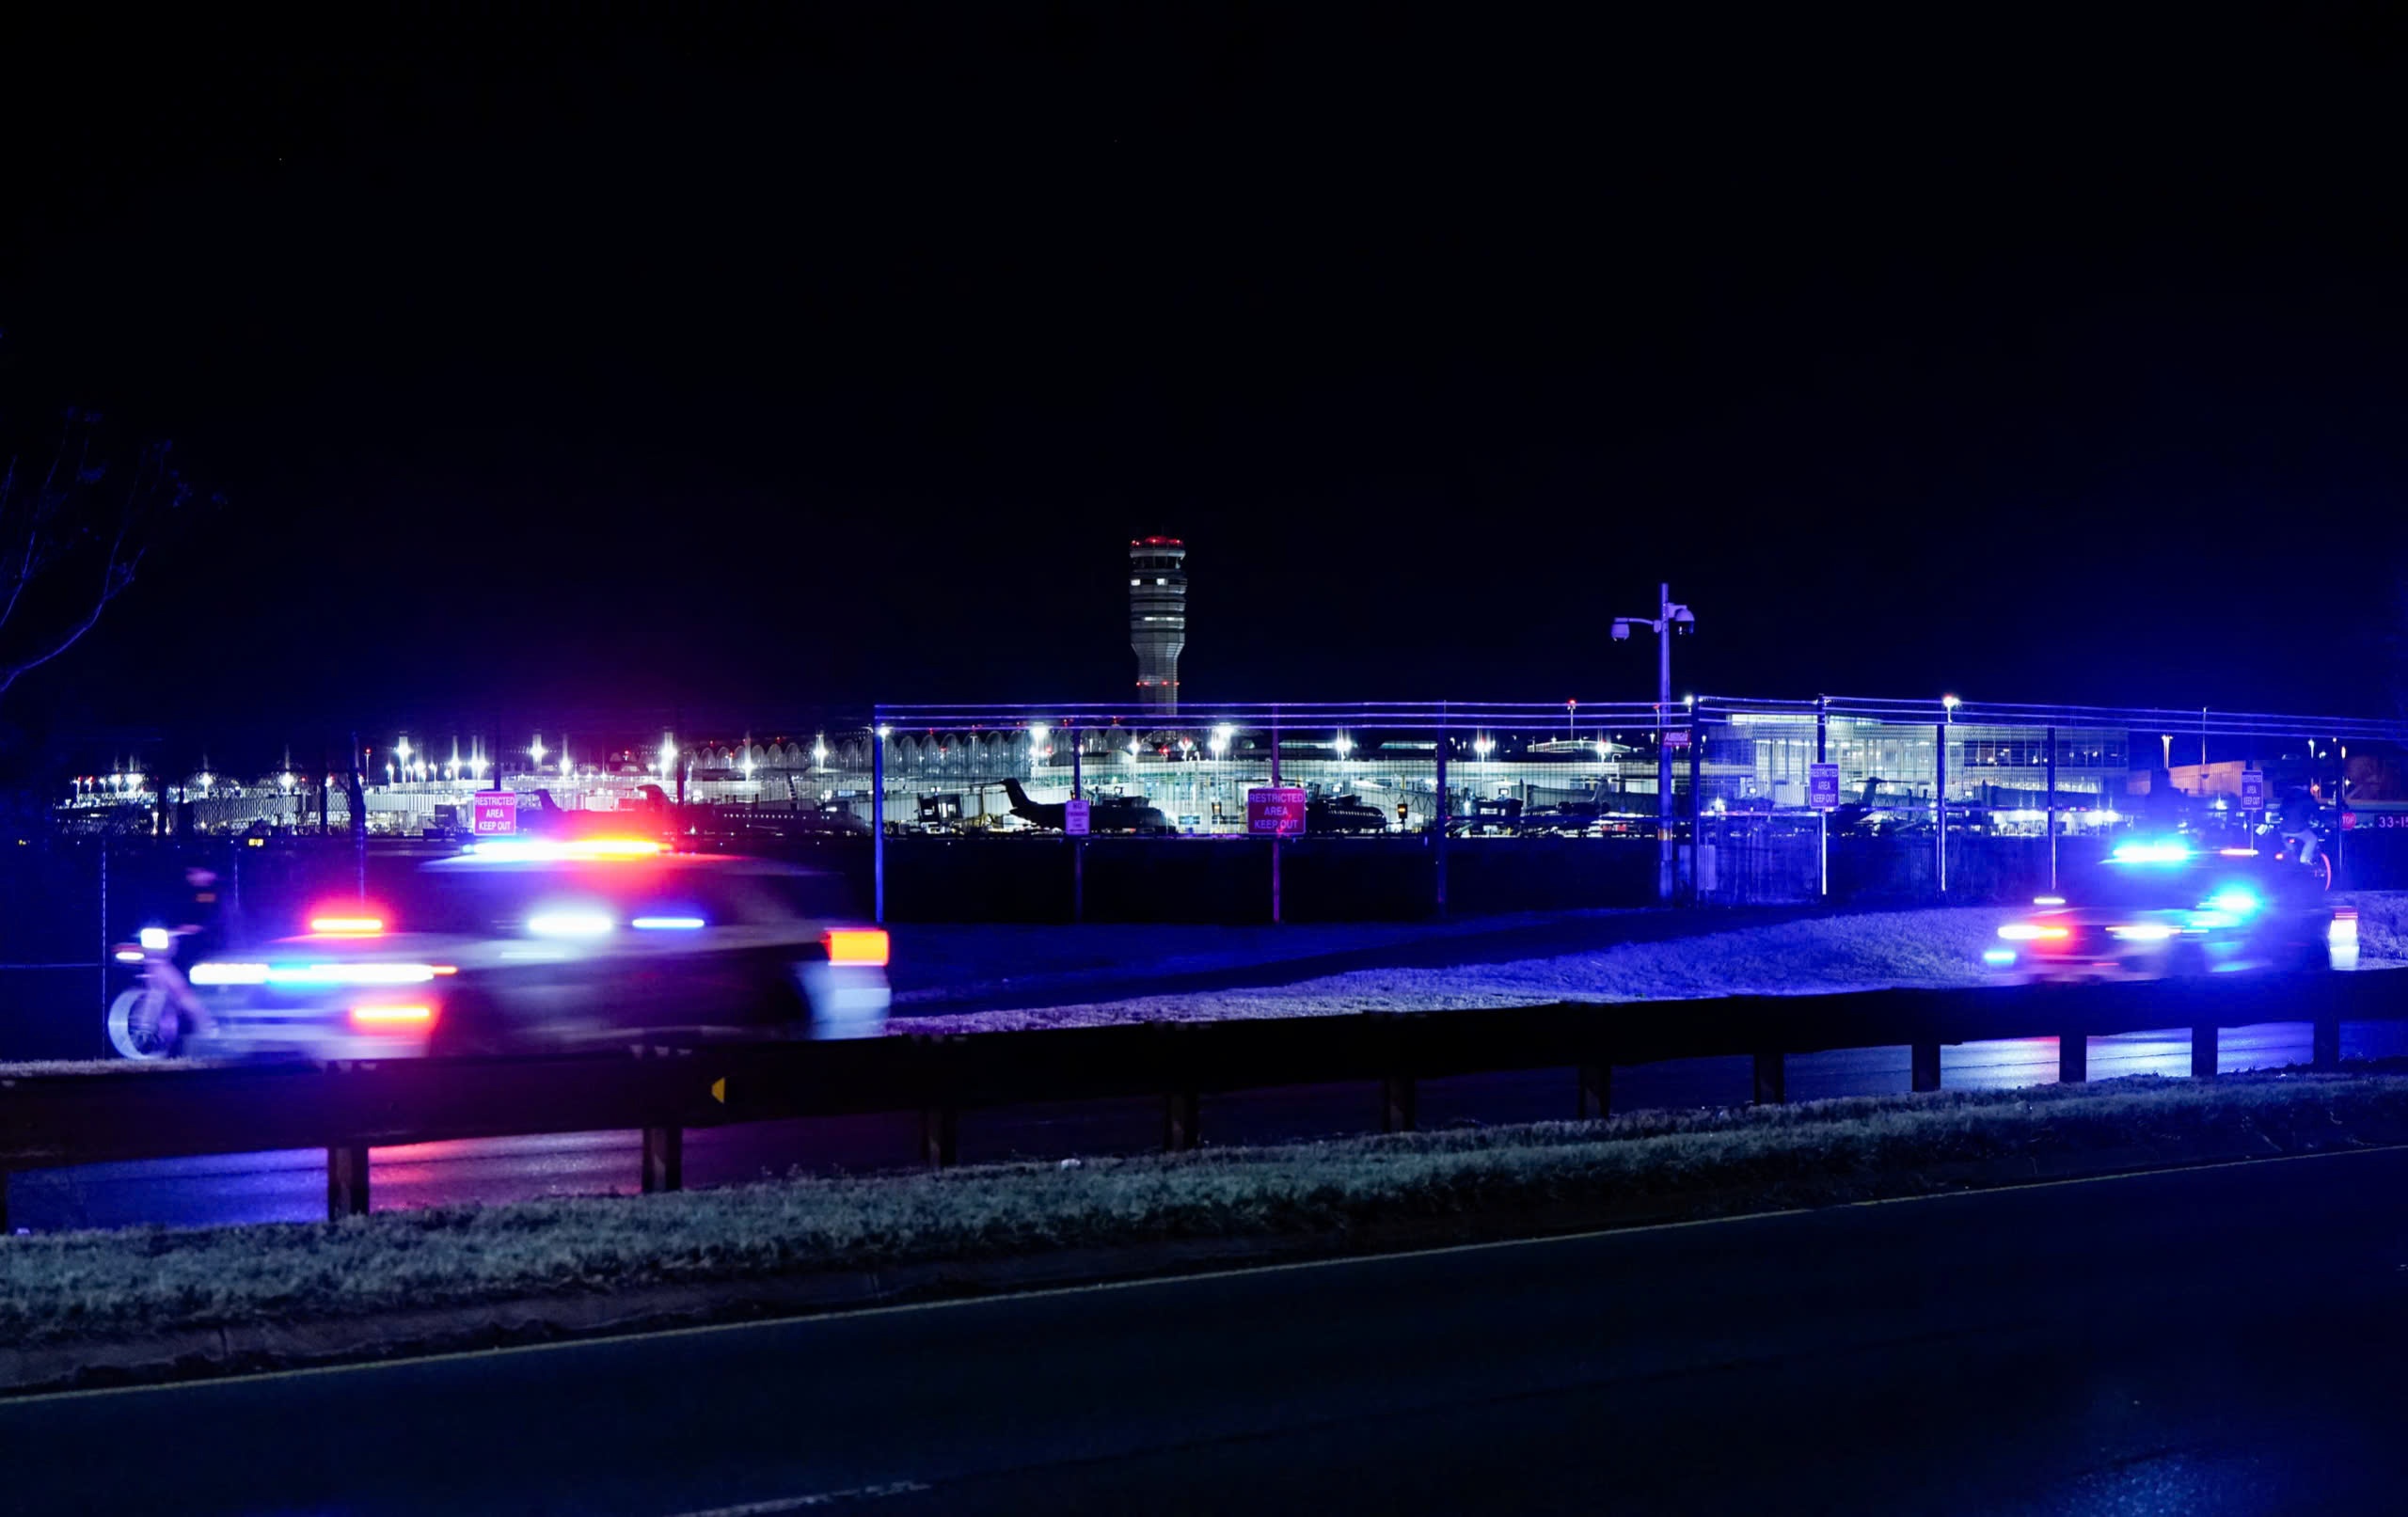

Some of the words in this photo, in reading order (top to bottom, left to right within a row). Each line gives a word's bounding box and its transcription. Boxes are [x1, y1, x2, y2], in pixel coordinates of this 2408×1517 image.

[475, 797, 515, 806] RESTRICTED
[1249, 793, 1304, 803] RESTRICTED
[1814, 794, 1825, 802] KEEP
[1826, 794, 1836, 803] OUT
[486, 809, 504, 818] AREA
[1264, 806, 1289, 815] AREA
[1254, 820, 1278, 829] KEEP
[1280, 820, 1298, 829] OUT
[2342, 815, 2355, 825] TOP
[479, 821, 497, 830] KEEP
[498, 821, 511, 830] OUT
